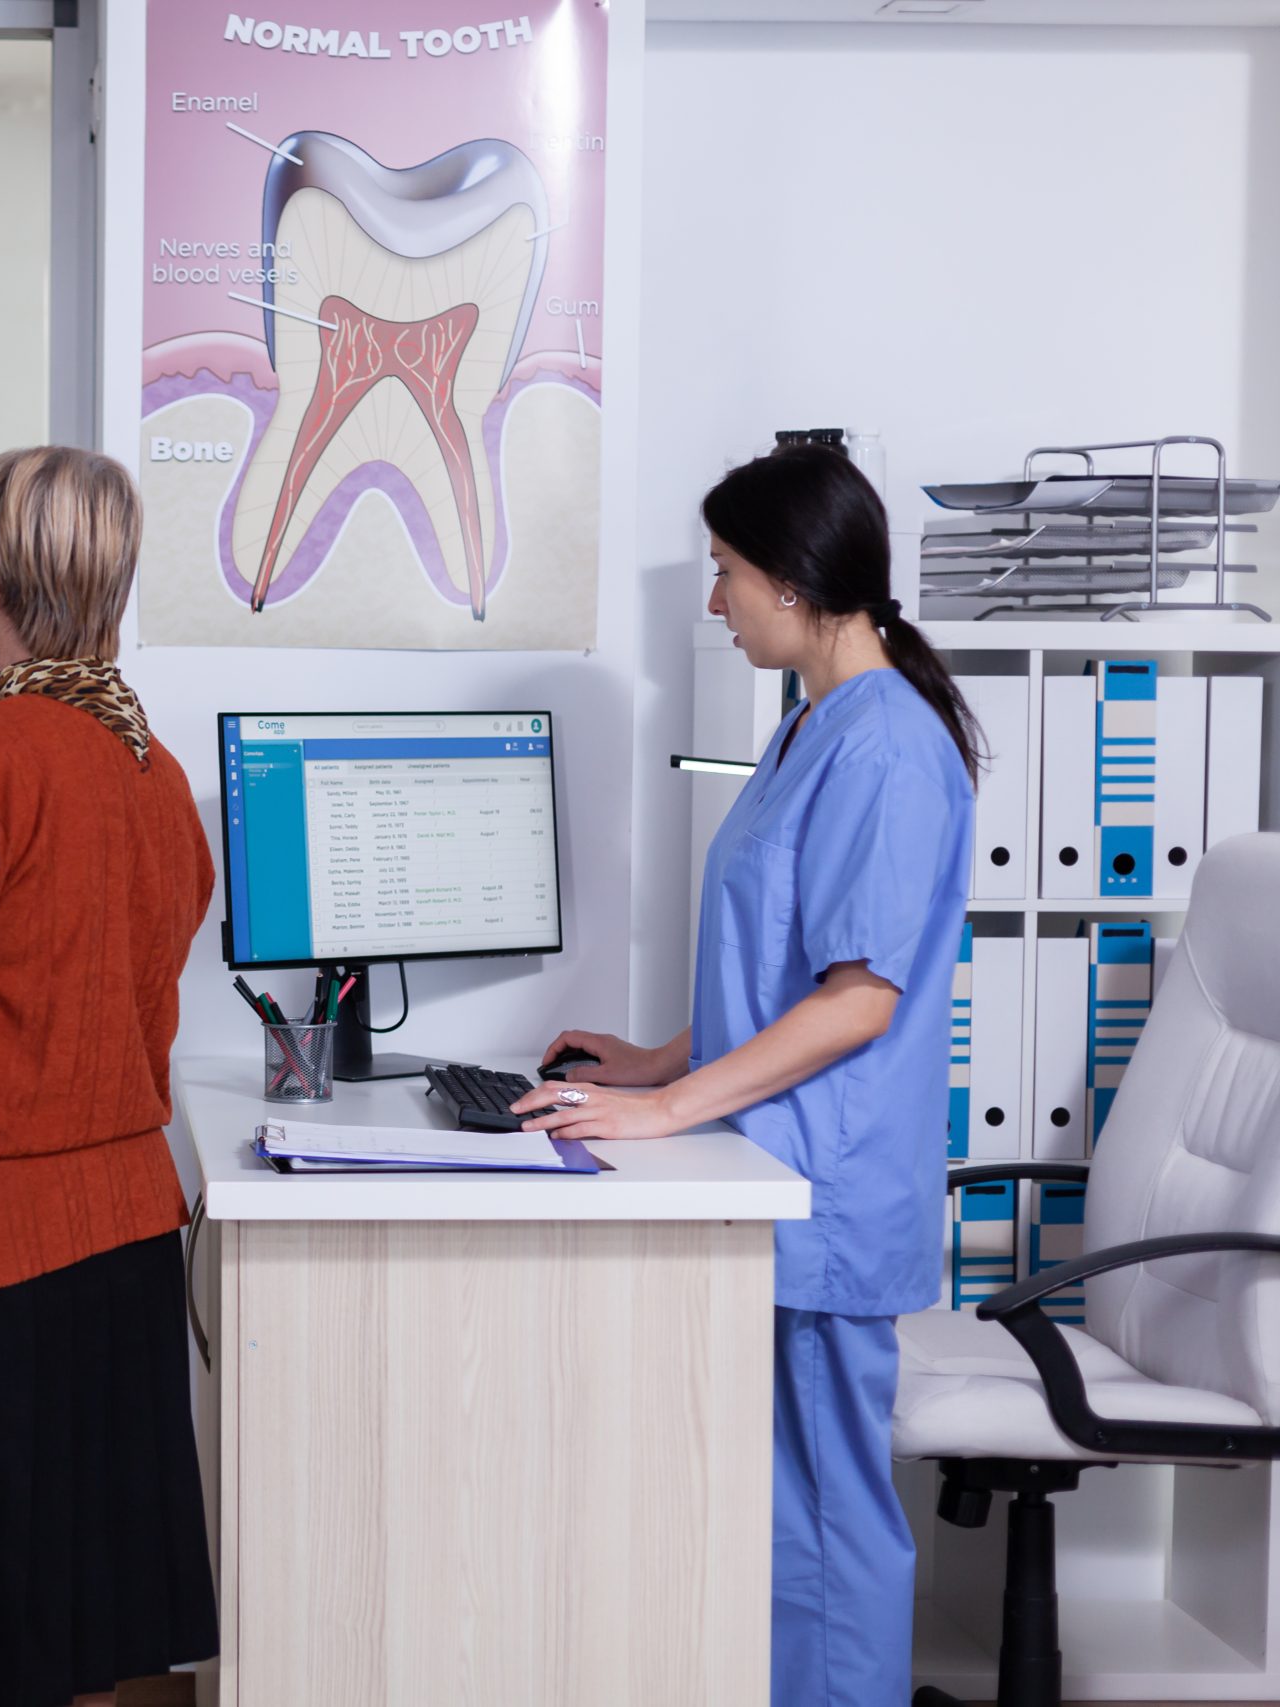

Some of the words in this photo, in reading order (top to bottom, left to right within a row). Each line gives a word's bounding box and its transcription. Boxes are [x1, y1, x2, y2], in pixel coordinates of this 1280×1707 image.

[224, 13, 391, 58] NORMAL
[400, 16, 533, 58] TOOTH
[172, 91, 258, 112] Enamel
[159, 238, 240, 258] Nerves
[248, 240, 292, 259] and
[152, 263, 220, 283] blood
[546, 296, 599, 316] Gum
[150, 436, 233, 462] Bone
[258, 720, 285, 730] Come
